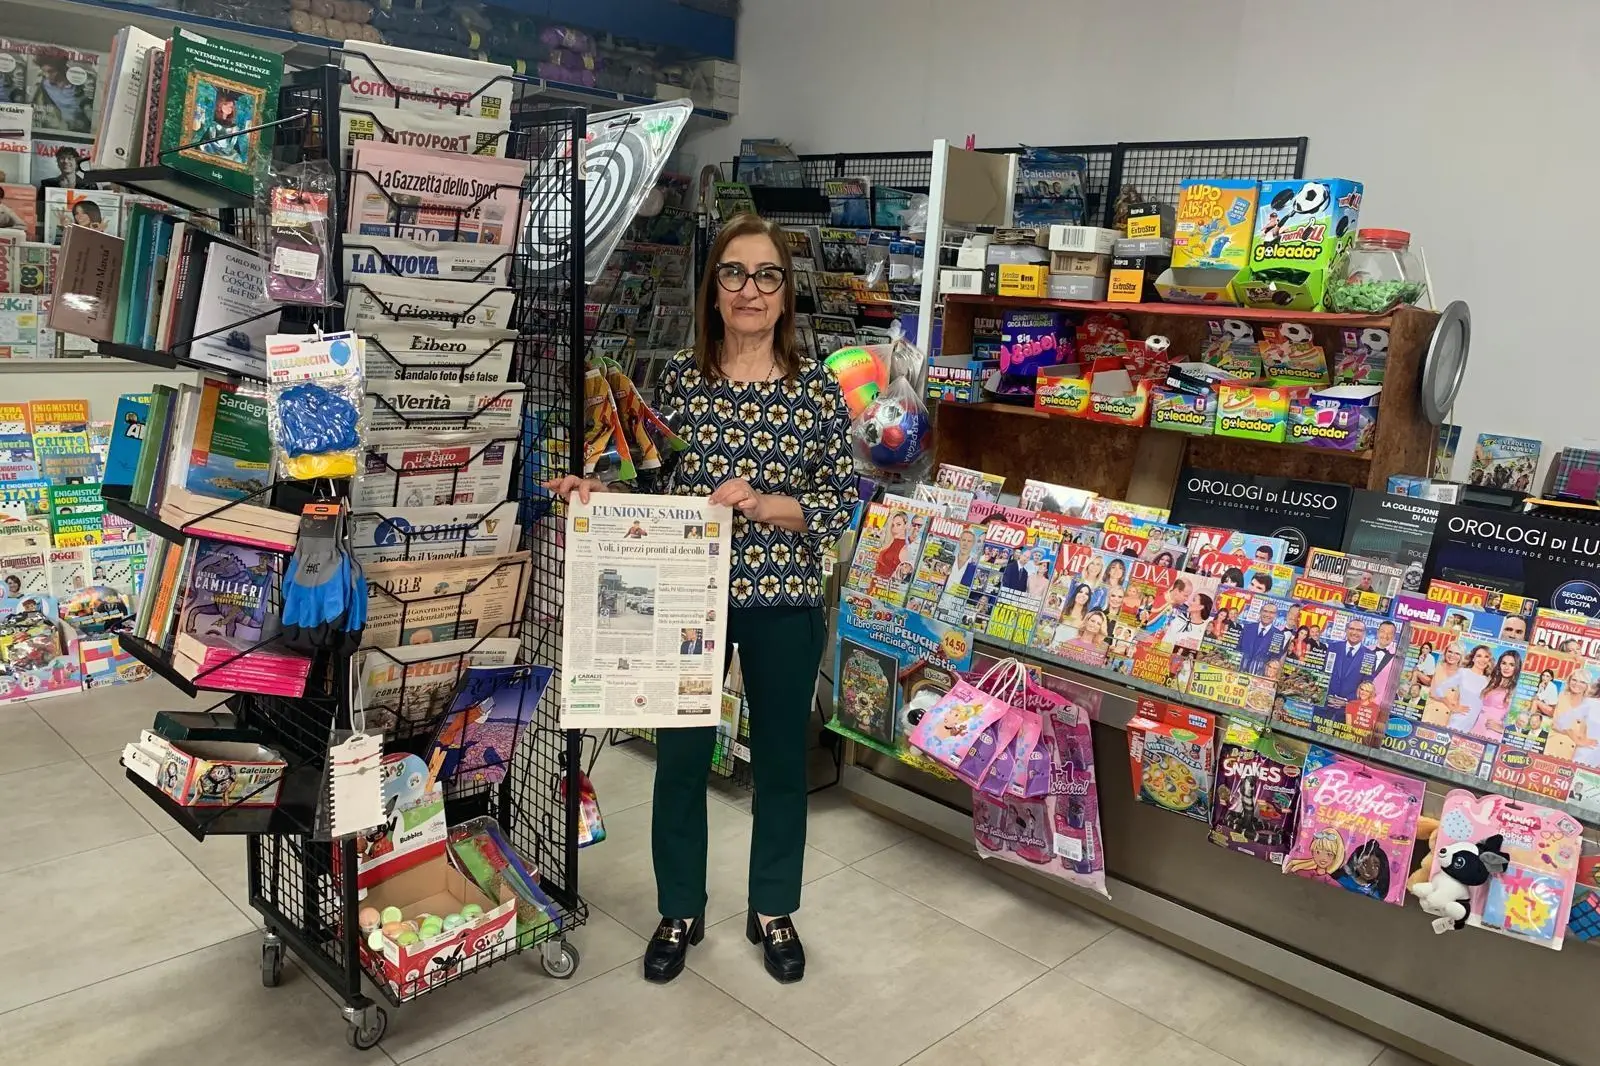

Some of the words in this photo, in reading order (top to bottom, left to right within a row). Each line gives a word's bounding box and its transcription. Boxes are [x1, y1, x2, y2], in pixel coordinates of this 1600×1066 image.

[186, 47, 229, 65] SENTIMENTI
[235, 60, 271, 76] SENTENZE
[378, 169, 389, 188] La
[393, 170, 442, 195] Gazzetta
[443, 176, 469, 197] dello
[471, 180, 499, 201] Sport
[1187, 184, 1222, 201] LUPO
[1180, 201, 1224, 219] ALBERTO
[1256, 244, 1321, 261] goleador
[226, 255, 250, 268] CARLO
[352, 254, 377, 275] LA
[381, 255, 439, 275] NUOVA
[225, 266, 235, 276] La
[222, 275, 264, 294] COSCIEN
[397, 304, 476, 326] Giornale
[410, 335, 467, 353] Libero
[395, 370, 438, 382] Sandalo
[439, 371, 458, 382] foto
[476, 371, 499, 382] false
[928, 366, 949, 378] NEW
[950, 368, 972, 380] YORK
[1270, 366, 1322, 380] goleador
[928, 378, 972, 388] BLACK
[33, 404, 84, 413] ENIGMISTICA
[219, 393, 268, 418] Sardegn
[1040, 395, 1080, 408] goleador
[1094, 402, 1135, 416] goleador
[1157, 410, 1205, 424] goleador
[1222, 418, 1275, 433] goleador
[904, 415, 919, 463] SARDEGNA
[1293, 424, 1349, 440] goleador
[936, 467, 973, 490] GENTE
[54, 488, 101, 498] ENIGMISTICA
[55, 496, 78, 504] MOLTO
[79, 495, 103, 503] FACILE
[1187, 478, 1263, 501] OROLOGI
[1266, 492, 1279, 503] DI
[1281, 490, 1338, 511] LUSSO
[592, 506, 655, 519] L'UNIONE
[658, 508, 702, 520] SARDA
[970, 502, 1032, 525] confidenze
[1218, 501, 1260, 511] LEGGENDE
[1284, 510, 1312, 518] TEMPO
[1382, 501, 1392, 509] LA
[1392, 502, 1440, 516] COLLEZIONE
[58, 517, 101, 526] ENIGMISTIC
[58, 525, 82, 533] MOLTO
[83, 523, 102, 532] FACIL
[866, 514, 888, 529] TV
[930, 518, 964, 538] NUOVO
[986, 523, 1025, 546] VERO
[1448, 516, 1547, 546] OROLOGI
[1550, 538, 1566, 550] DI
[1572, 536, 1600, 556] LU
[621, 544, 644, 555] prezzi
[645, 544, 668, 555] pronti
[669, 544, 678, 554] al
[678, 545, 705, 555] decollo
[1104, 534, 1143, 554] Ciao
[1061, 544, 1092, 574] Vip
[1408, 550, 1428, 559] ROLE
[1488, 544, 1542, 560] LEGGENDE
[1548, 555, 1567, 564] DEL
[1574, 560, 1600, 569] TEMP
[1132, 562, 1171, 585] DIVA
[194, 576, 264, 598] CAMILLERI
[1294, 584, 1343, 602] GIALLO
[1219, 594, 1246, 614] TV
[1428, 586, 1482, 606] GIALLO
[1562, 590, 1598, 602] SECONDA
[1564, 599, 1591, 609] USCITA
[411, 605, 438, 616] Governo
[1397, 602, 1442, 623] Novella
[1300, 610, 1327, 633] TV
[853, 617, 871, 630] Libro
[872, 622, 886, 631] con
[894, 626, 939, 653] PELUCHE
[870, 632, 907, 650] ufficiale
[908, 644, 917, 655] di
[919, 646, 958, 672] Westie
[1190, 682, 1214, 696] SOLO
[1410, 748, 1422, 758] IN
[1424, 751, 1442, 764] PIÙ
[1223, 758, 1282, 783] SNAKES
[1494, 768, 1526, 785] SOLO
[1528, 772, 1540, 783] €
[1050, 781, 1090, 796] sicura!
[1313, 768, 1406, 820] Barbie
[1528, 784, 1540, 792] IN
[400, 830, 424, 844] Bubbles
[473, 928, 506, 953] Bing
